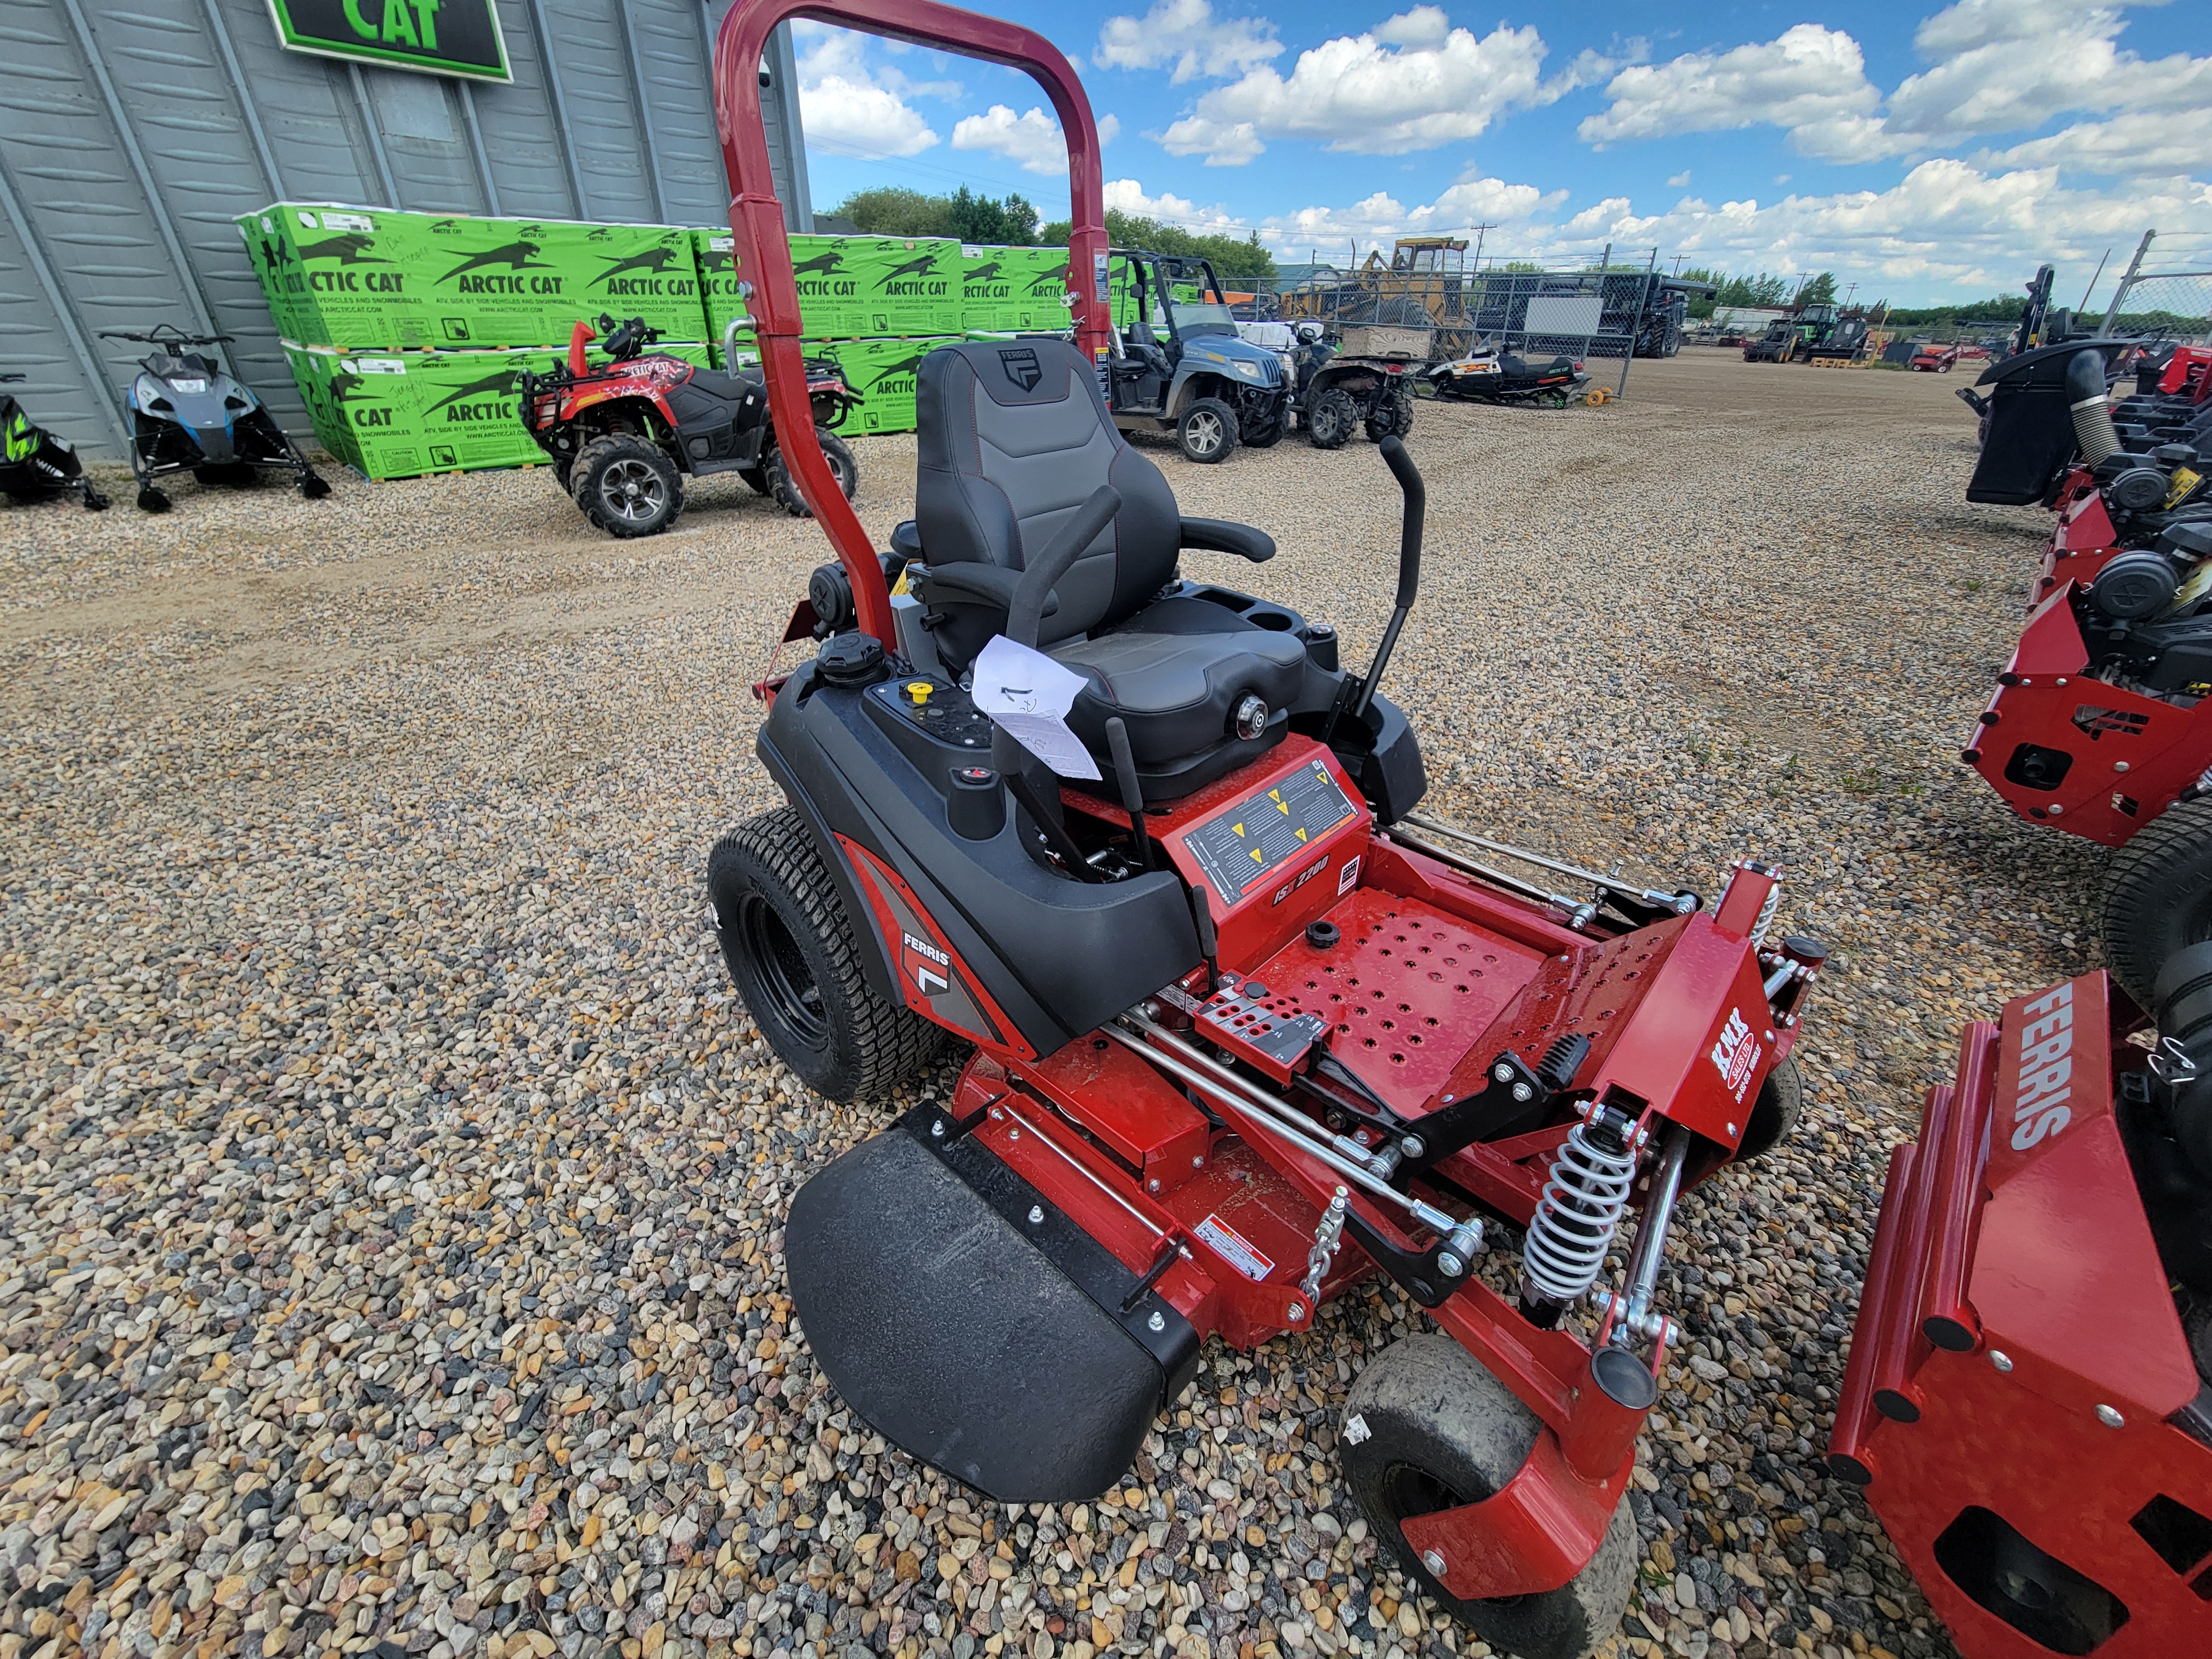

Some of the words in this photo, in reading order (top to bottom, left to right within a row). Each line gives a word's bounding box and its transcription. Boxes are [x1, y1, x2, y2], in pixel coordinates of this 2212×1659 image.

[342, 0, 439, 50] CAT
[308, 271, 359, 292] CTIC
[365, 272, 404, 292] CAT
[459, 275, 526, 294] ARCTIC
[531, 276, 562, 294] CAT
[607, 278, 663, 295] ARCTIC
[667, 279, 695, 295] CAT
[796, 280, 832, 296] RCTIC
[834, 281, 856, 296] CAT
[885, 281, 925, 296] ARCTIC
[928, 281, 948, 296] CAT
[1032, 285, 1062, 297] ARCTIC
[964, 285, 991, 298] RCTIC
[994, 286, 1010, 298] CAT
[1001, 349, 1034, 359] FERRIS
[877, 380, 915, 395] ARCTIC
[354, 408, 393, 427] CAT
[447, 403, 512, 422] ARCTIC
[361, 429, 410, 437] SNOWMOBILES
[1273, 878, 1297, 905] ISX
[1296, 854, 1329, 888] 2200
[904, 932, 949, 966] FERRIS
[1748, 1043, 1762, 1071] HUMBOLDT
[2011, 981, 2073, 1150] FERRIS
[1732, 1055, 1745, 1080] SALES
[1232, 1234, 1253, 1252] DANGER
